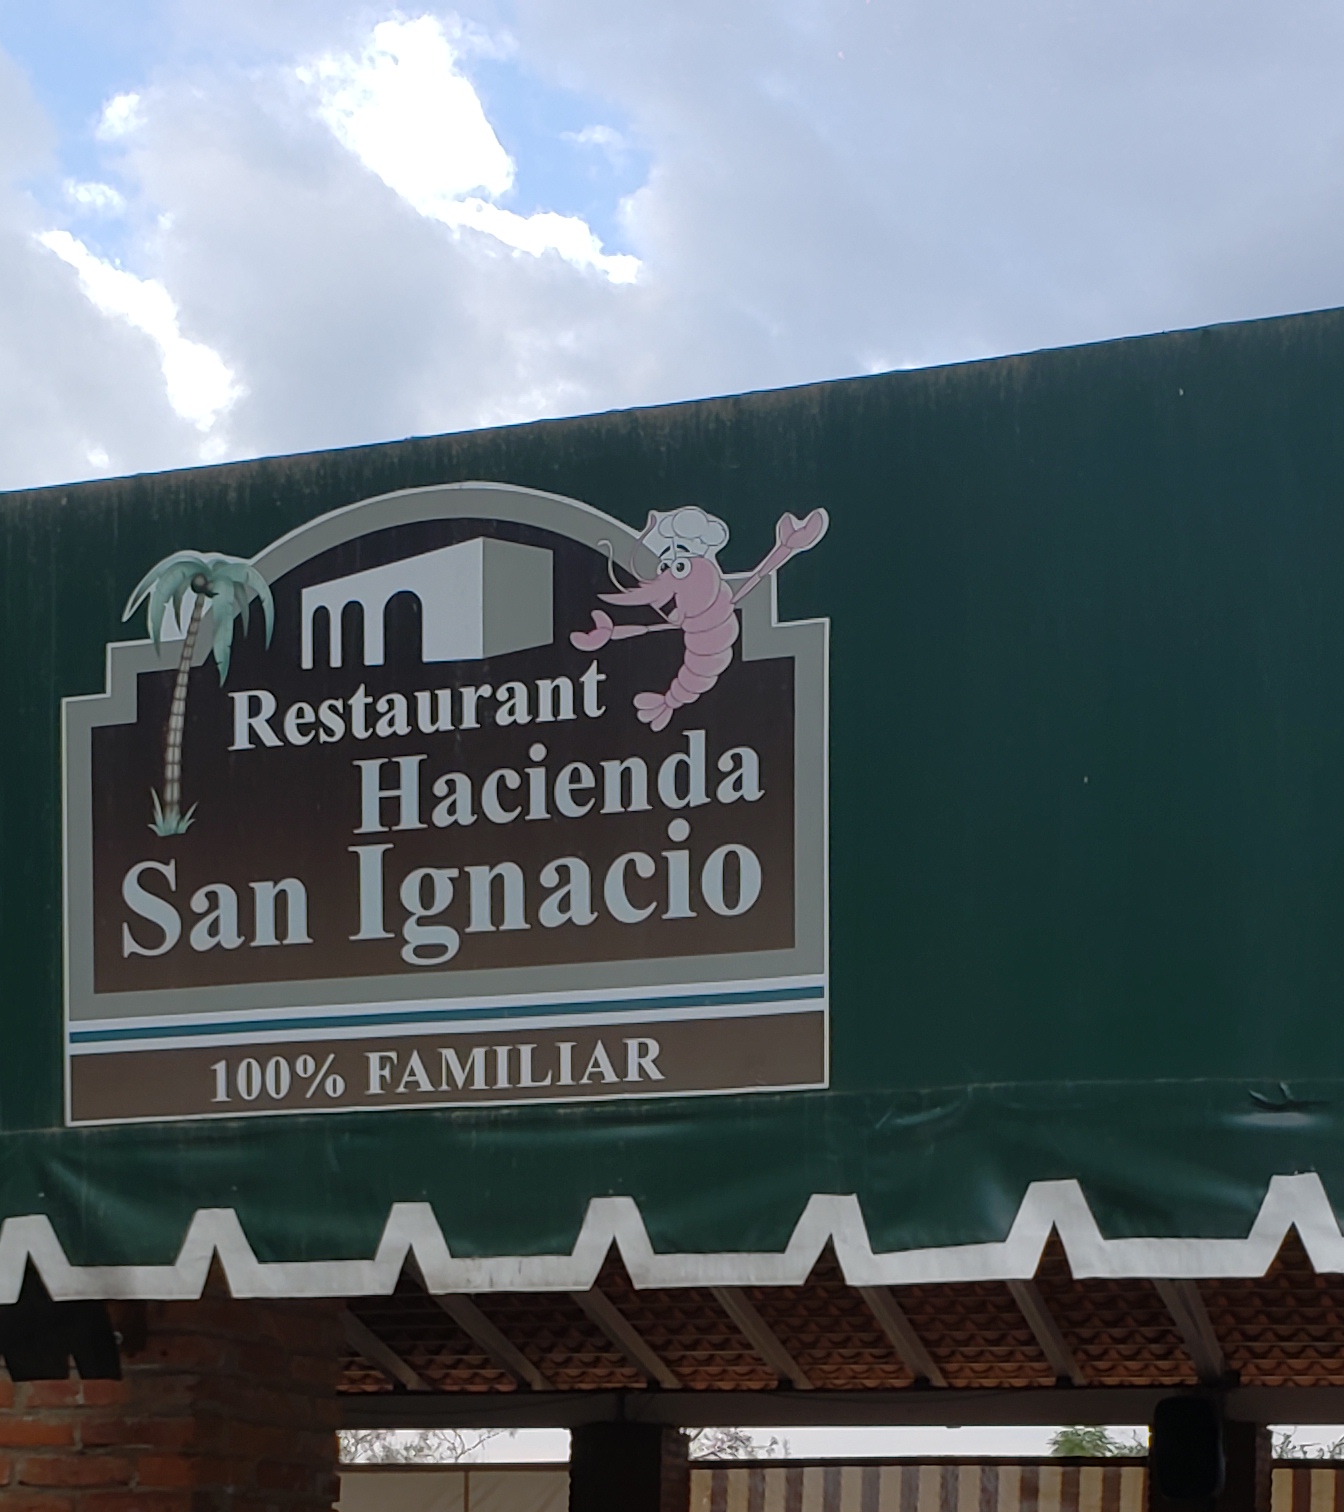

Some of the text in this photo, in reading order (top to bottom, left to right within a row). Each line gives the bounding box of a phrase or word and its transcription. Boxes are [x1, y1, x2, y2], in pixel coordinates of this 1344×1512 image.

[227, 659, 607, 752] Restaurant
[352, 729, 766, 836] Hacienda
[121, 817, 763, 967] San Ignacio
[209, 1036, 667, 1103] 100% FAMILIAR
